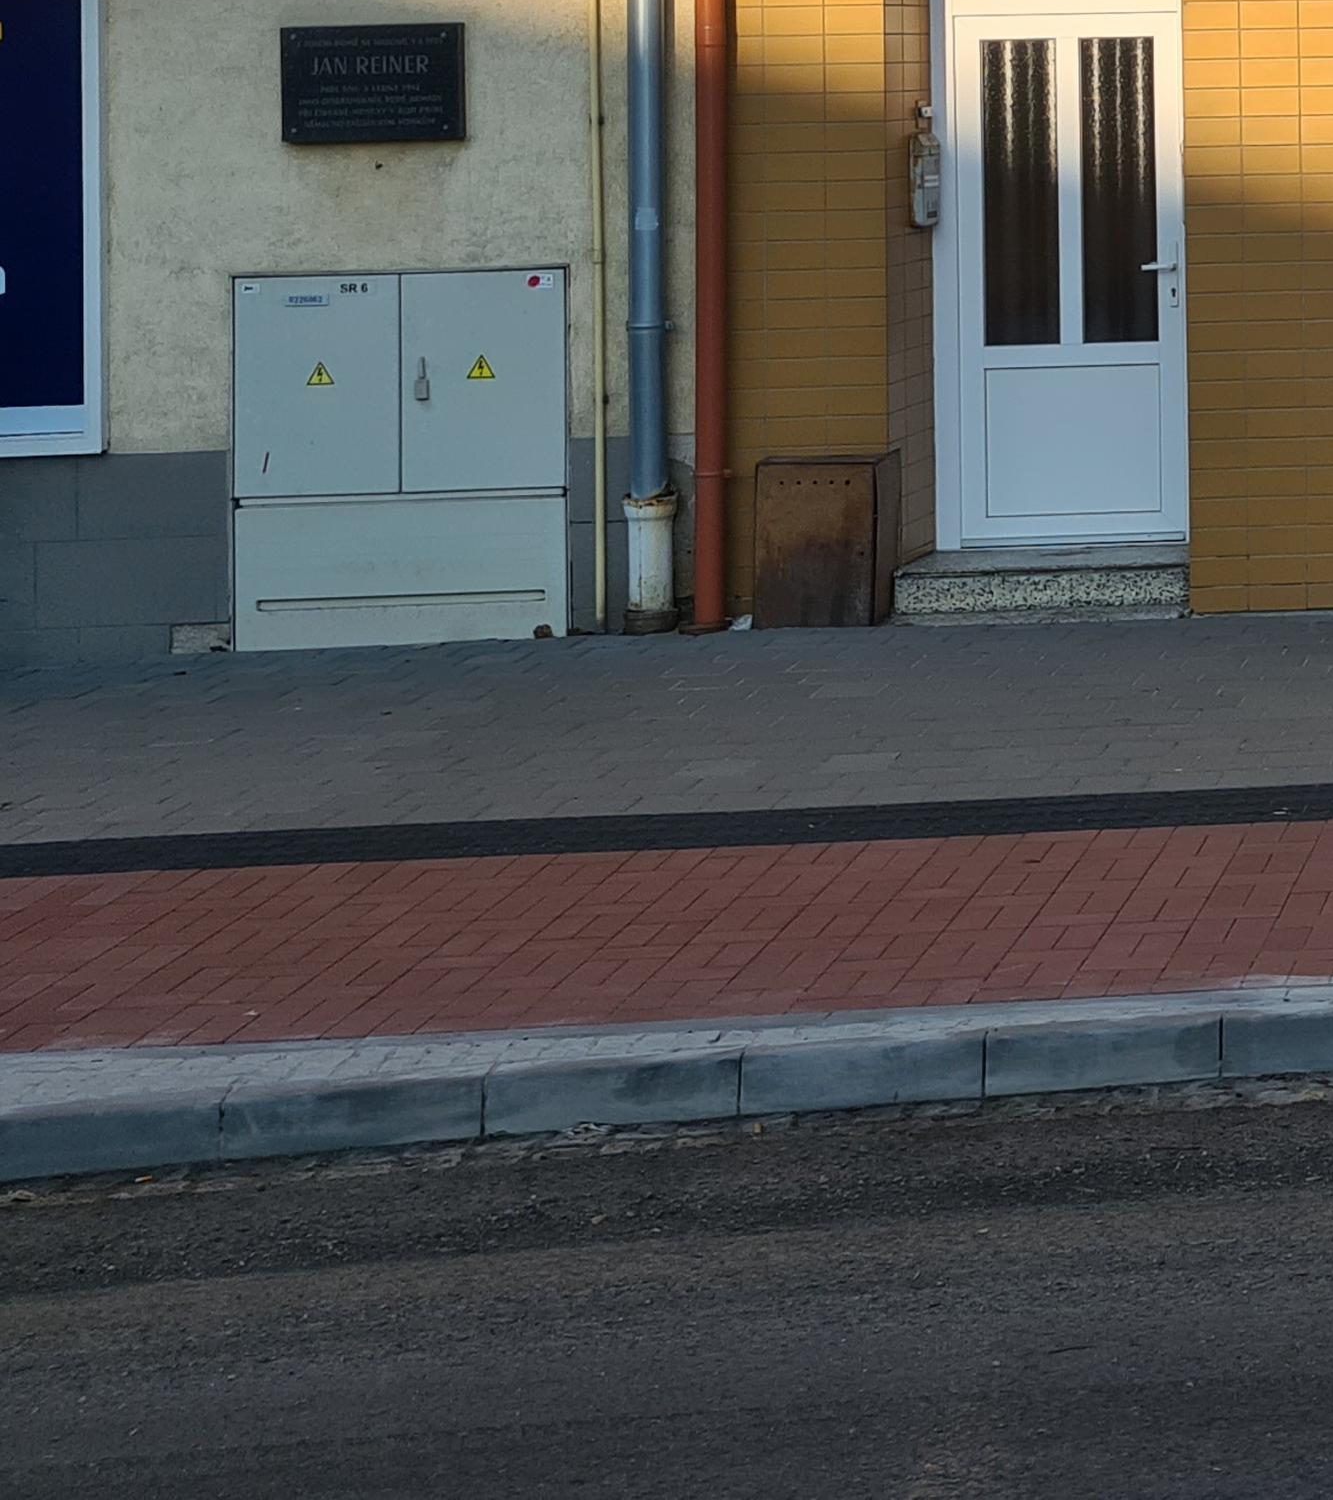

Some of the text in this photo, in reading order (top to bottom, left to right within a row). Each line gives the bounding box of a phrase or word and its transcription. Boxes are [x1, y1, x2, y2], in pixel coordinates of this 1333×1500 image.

[311, 54, 430, 76] JAN REINER
[340, 282, 369, 294] SR 6
